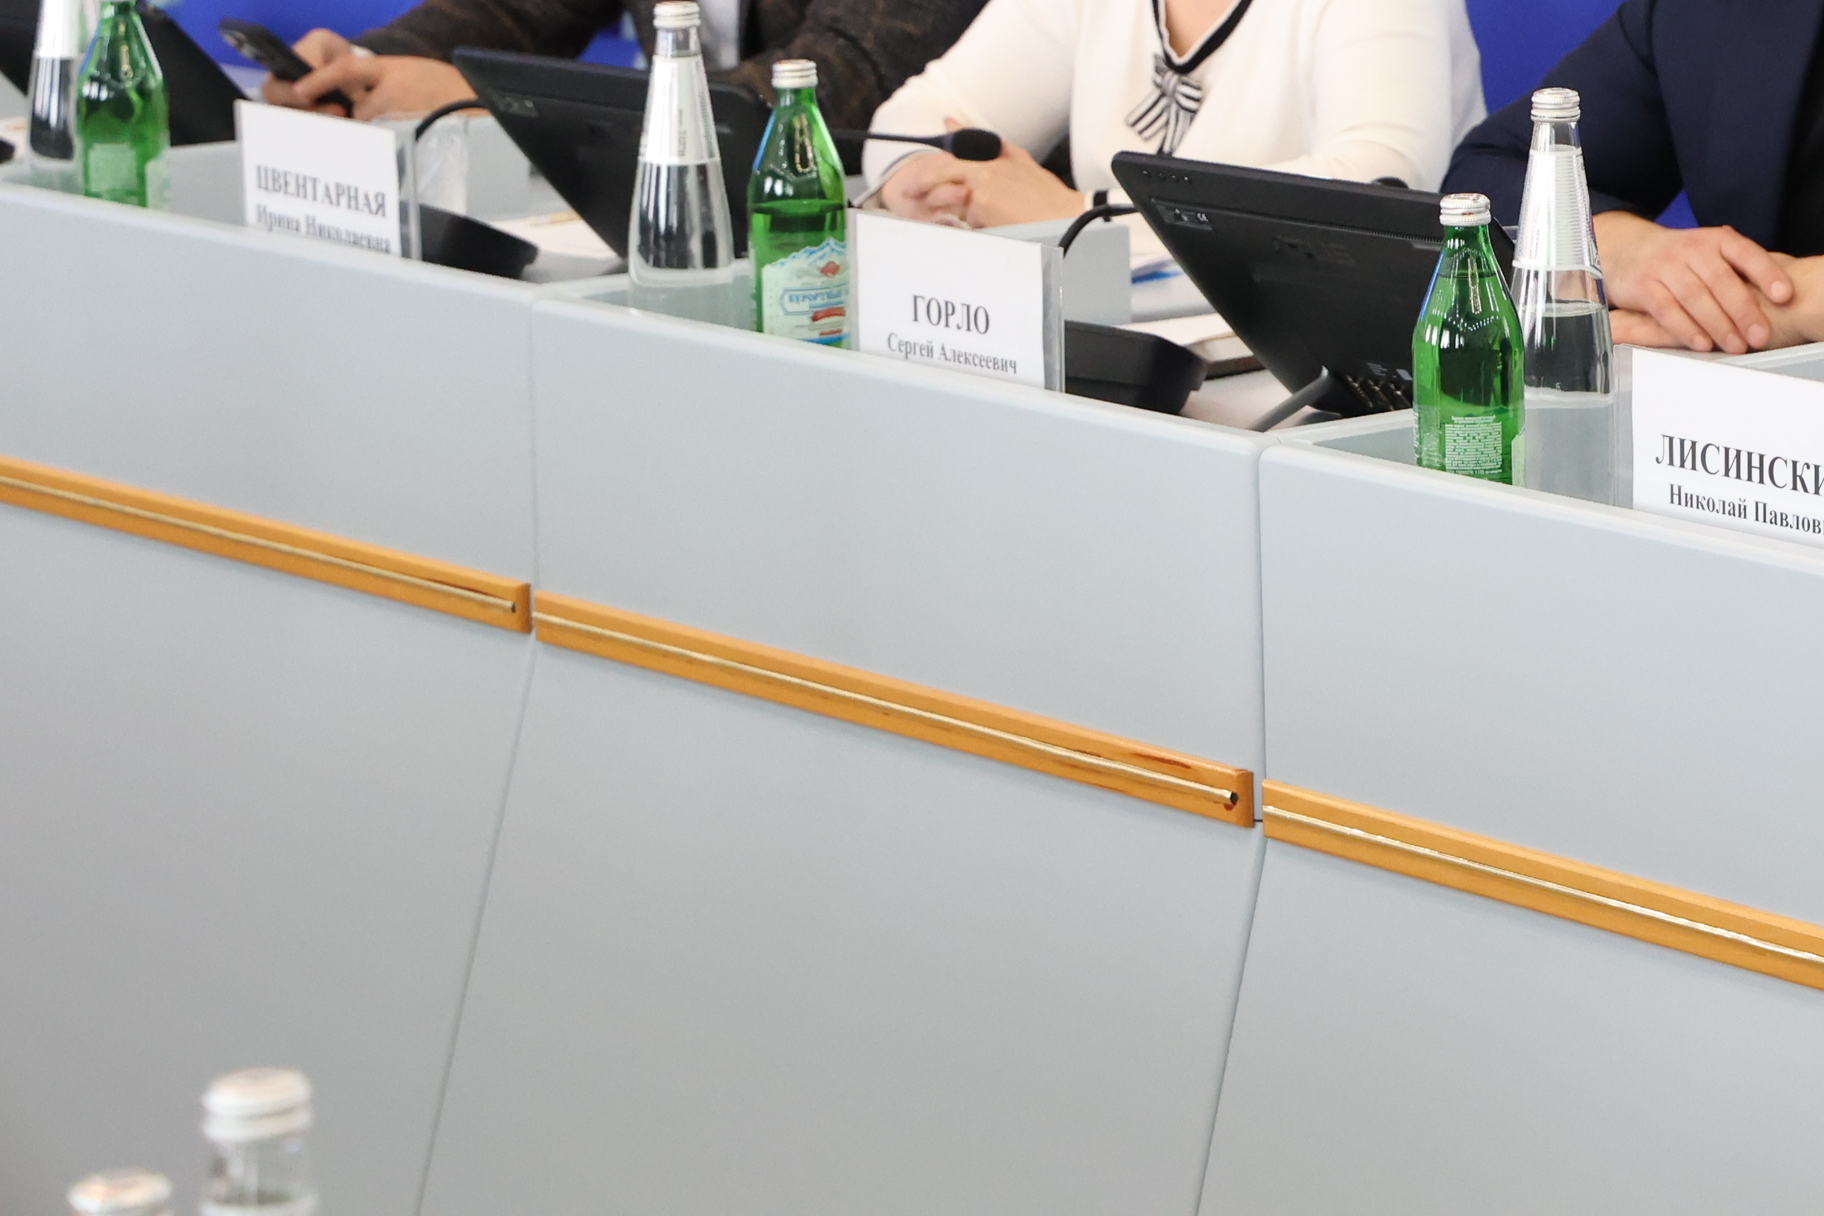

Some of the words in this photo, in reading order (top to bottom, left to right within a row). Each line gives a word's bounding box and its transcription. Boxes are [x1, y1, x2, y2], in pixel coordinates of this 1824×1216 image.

[257, 165, 387, 217] ЦВЕНТАРНАЯ
[256, 203, 301, 233] Ирина
[912, 295, 990, 335] ГОРЛО
[887, 333, 934, 360] Сергей
[939, 343, 1018, 374] Алексеевич
[1669, 483, 1748, 520] Николай
